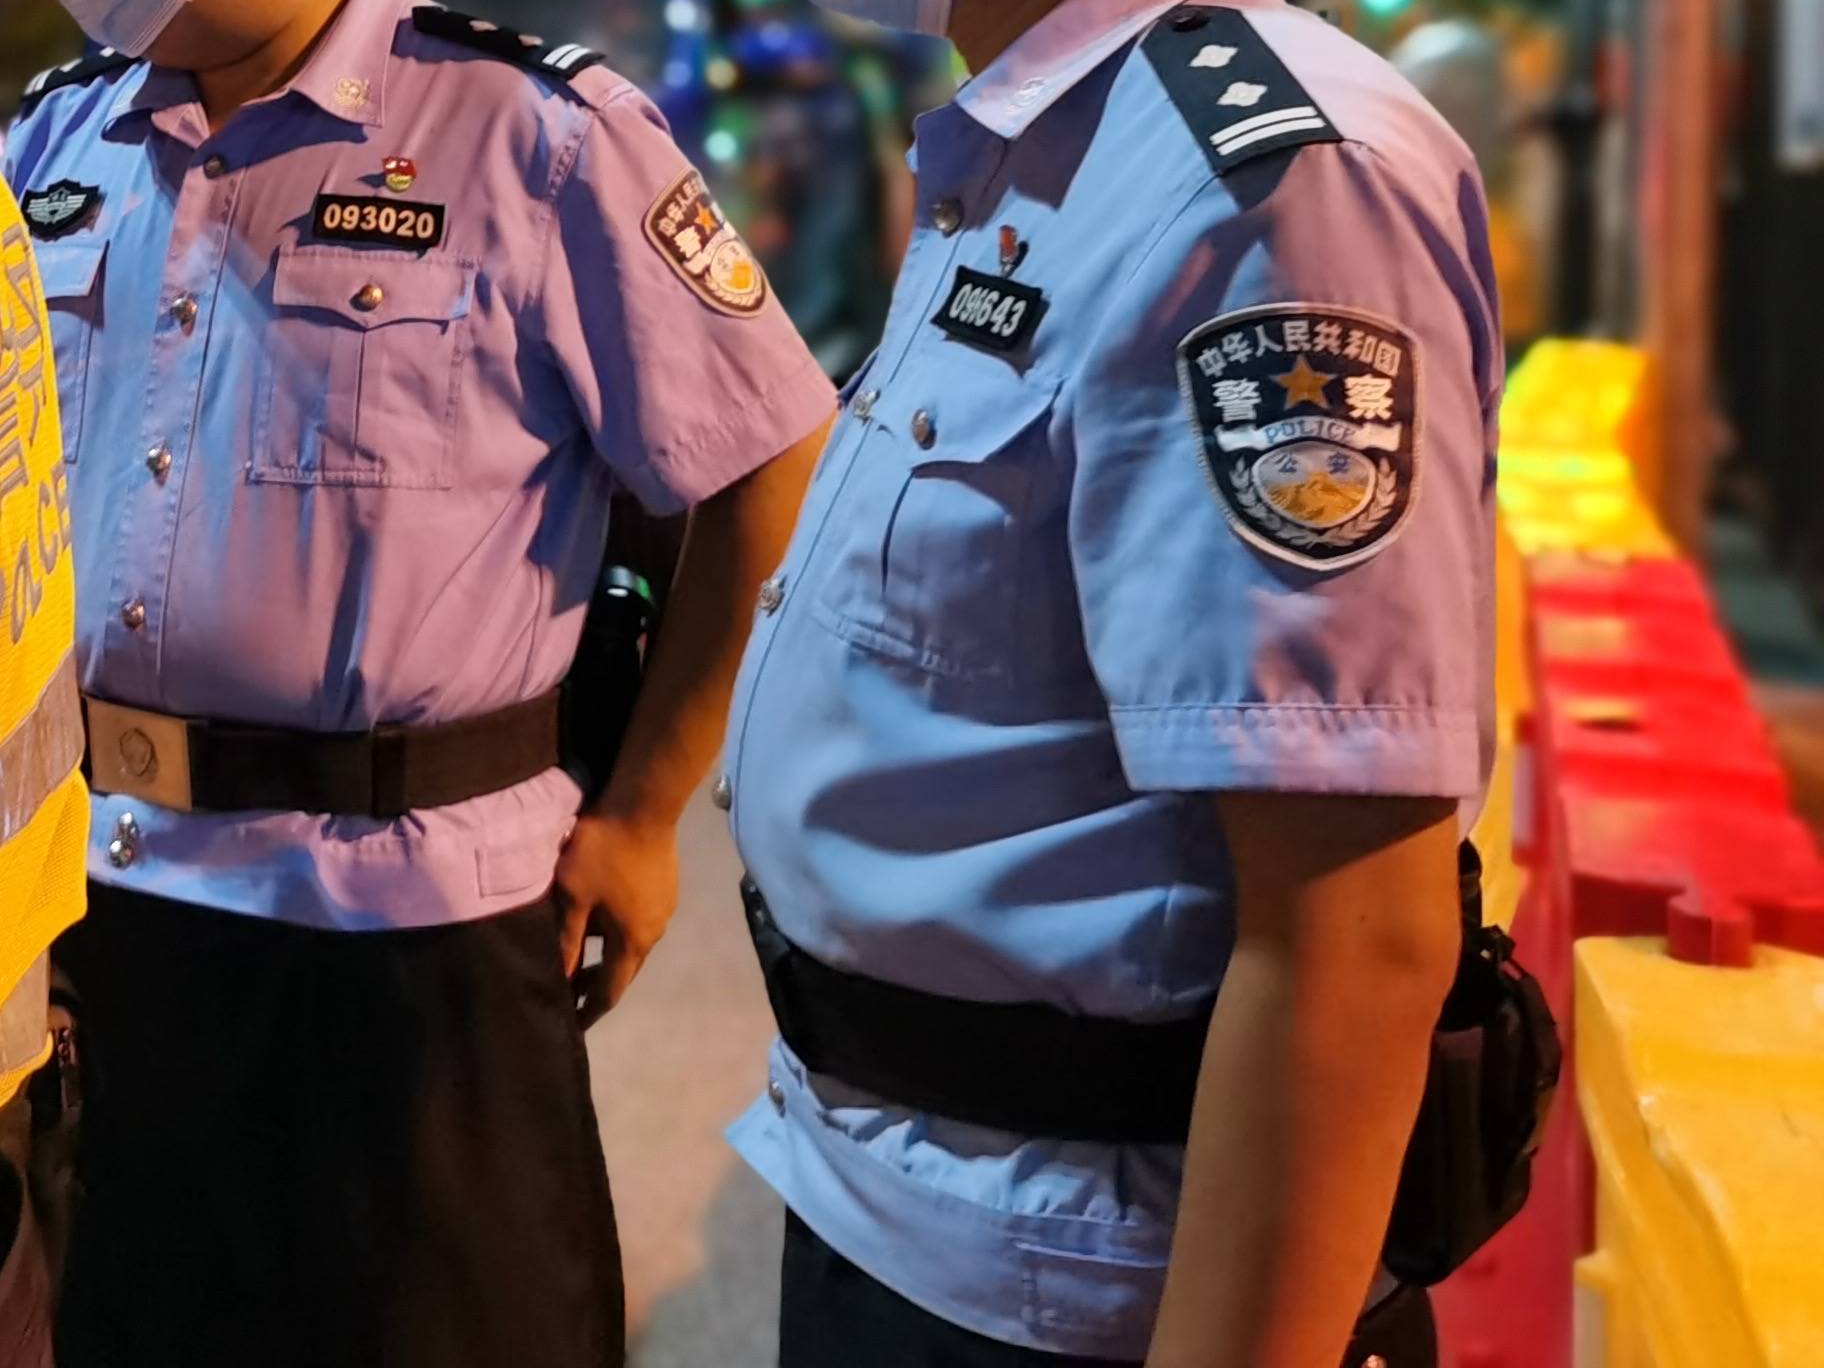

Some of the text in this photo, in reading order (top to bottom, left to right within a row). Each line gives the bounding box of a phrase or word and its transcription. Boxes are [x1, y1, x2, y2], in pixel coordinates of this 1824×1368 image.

[323, 203, 435, 239] 093020
[1196, 319, 1402, 377] 中华人民共和国
[1265, 420, 1357, 444] POLICE
